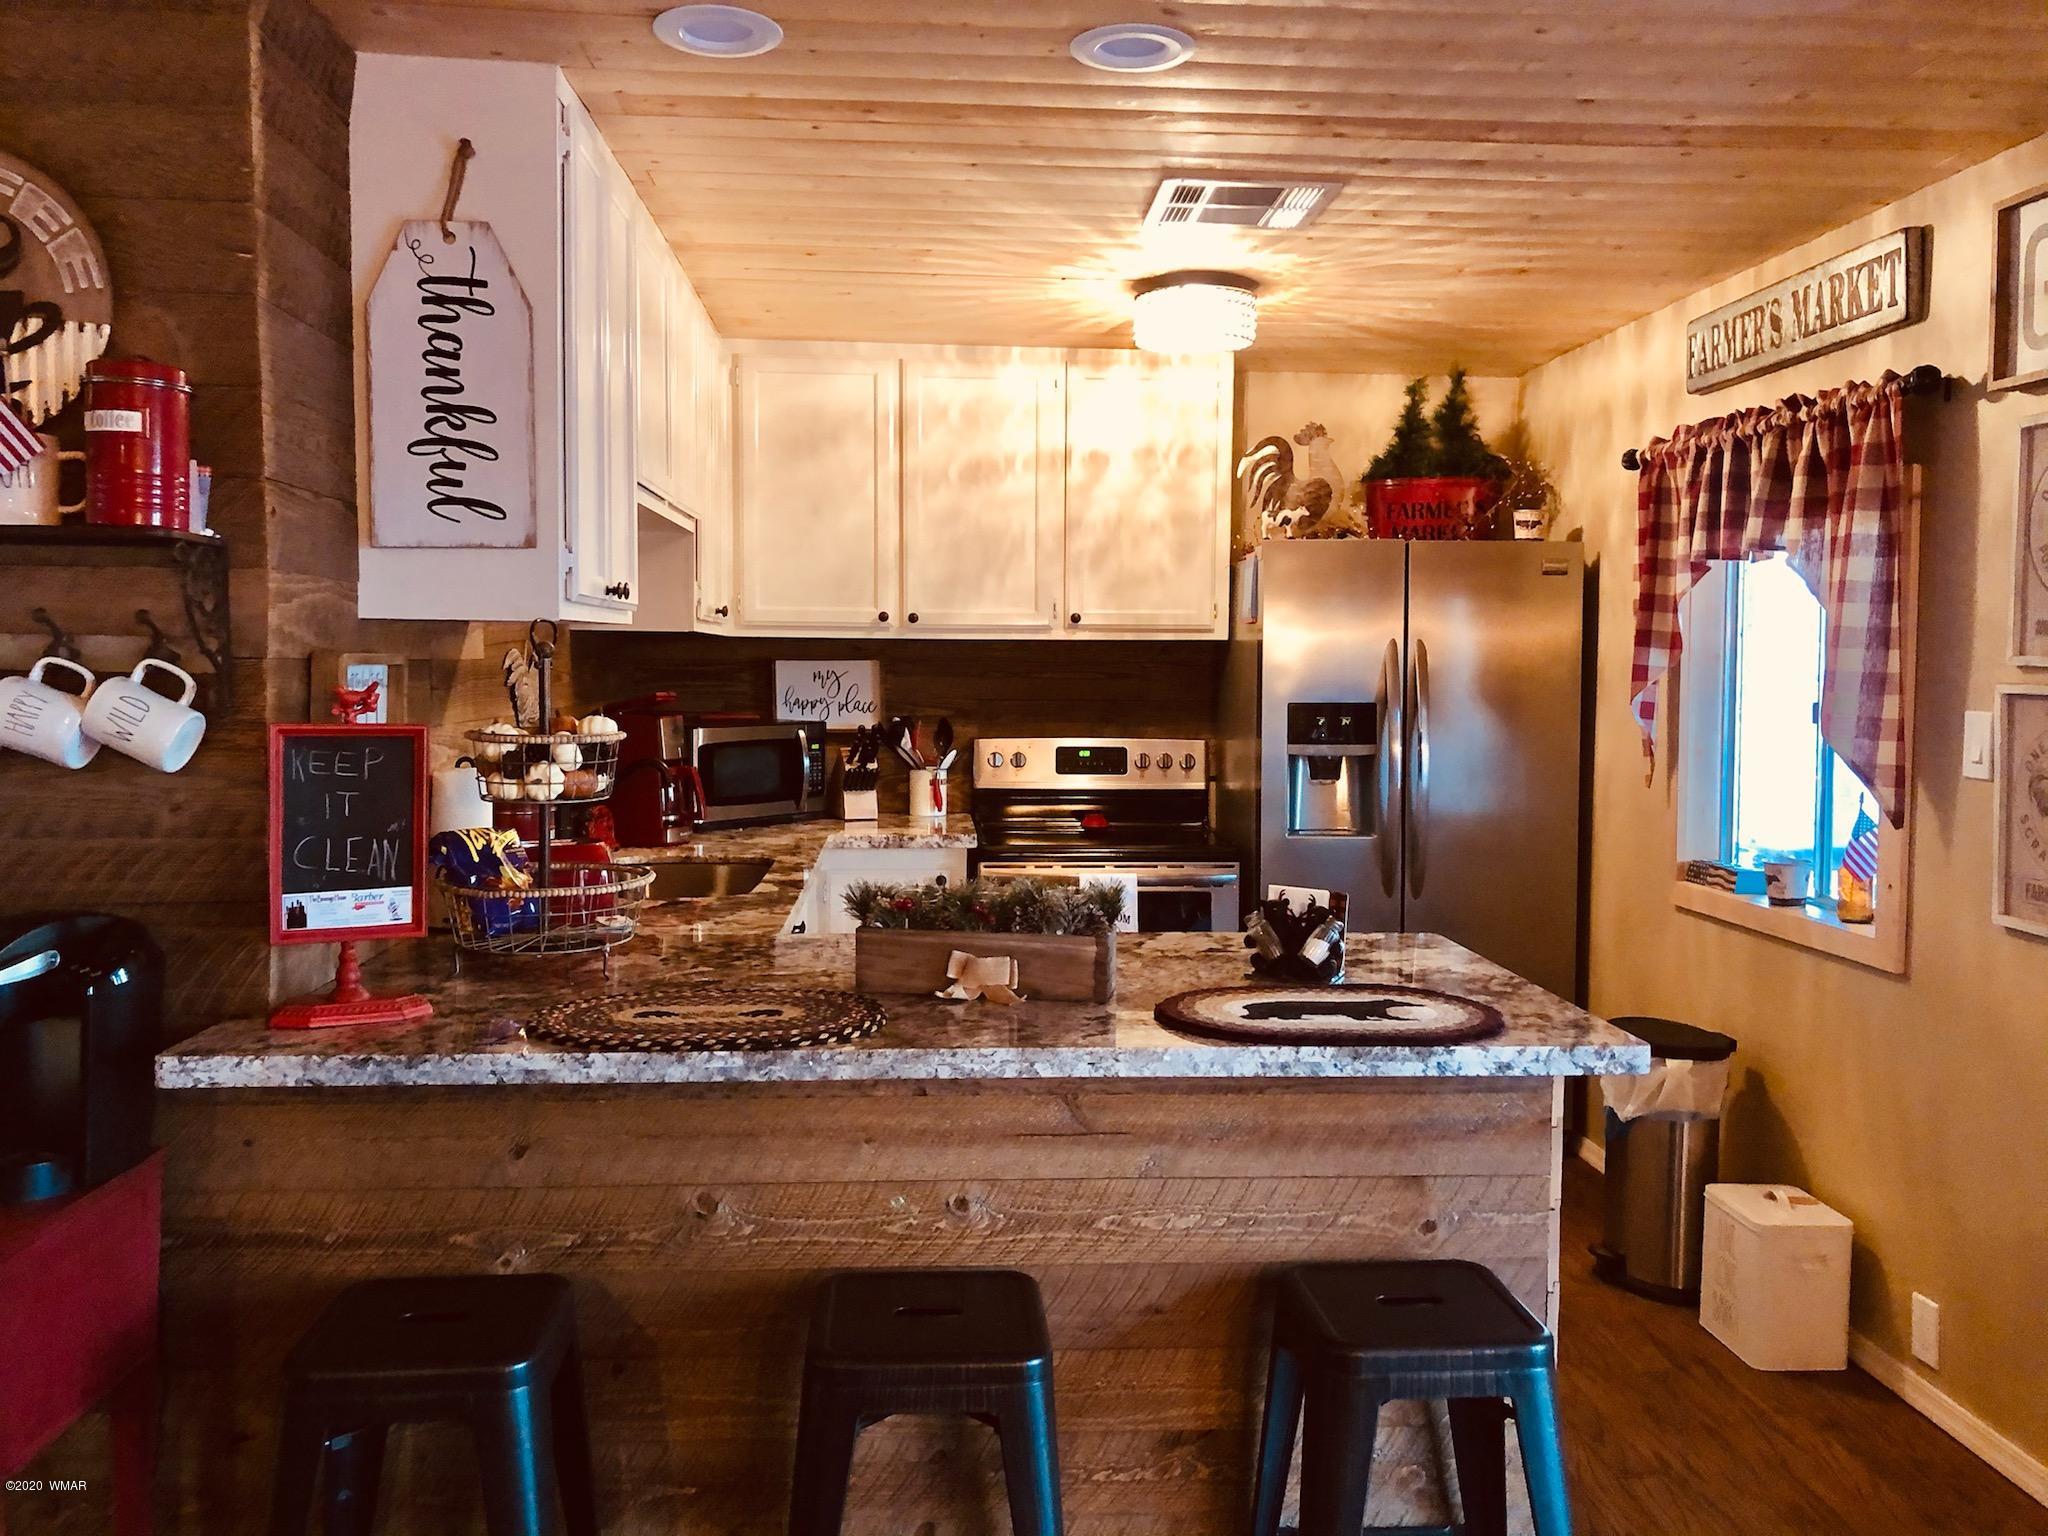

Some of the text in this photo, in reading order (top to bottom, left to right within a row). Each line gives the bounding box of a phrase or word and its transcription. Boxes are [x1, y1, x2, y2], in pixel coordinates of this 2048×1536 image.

[1688, 247, 1902, 380] FARMER'S MARKET
[404, 232, 507, 523] thankful
[782, 683, 878, 721] happy place
[812, 669, 849, 699] my
[4, 690, 54, 737] HAPPY
[103, 695, 151, 743] WILD
[291, 747, 384, 782] KEEP
[325, 791, 360, 820] IT
[293, 835, 400, 881] CLEAN
